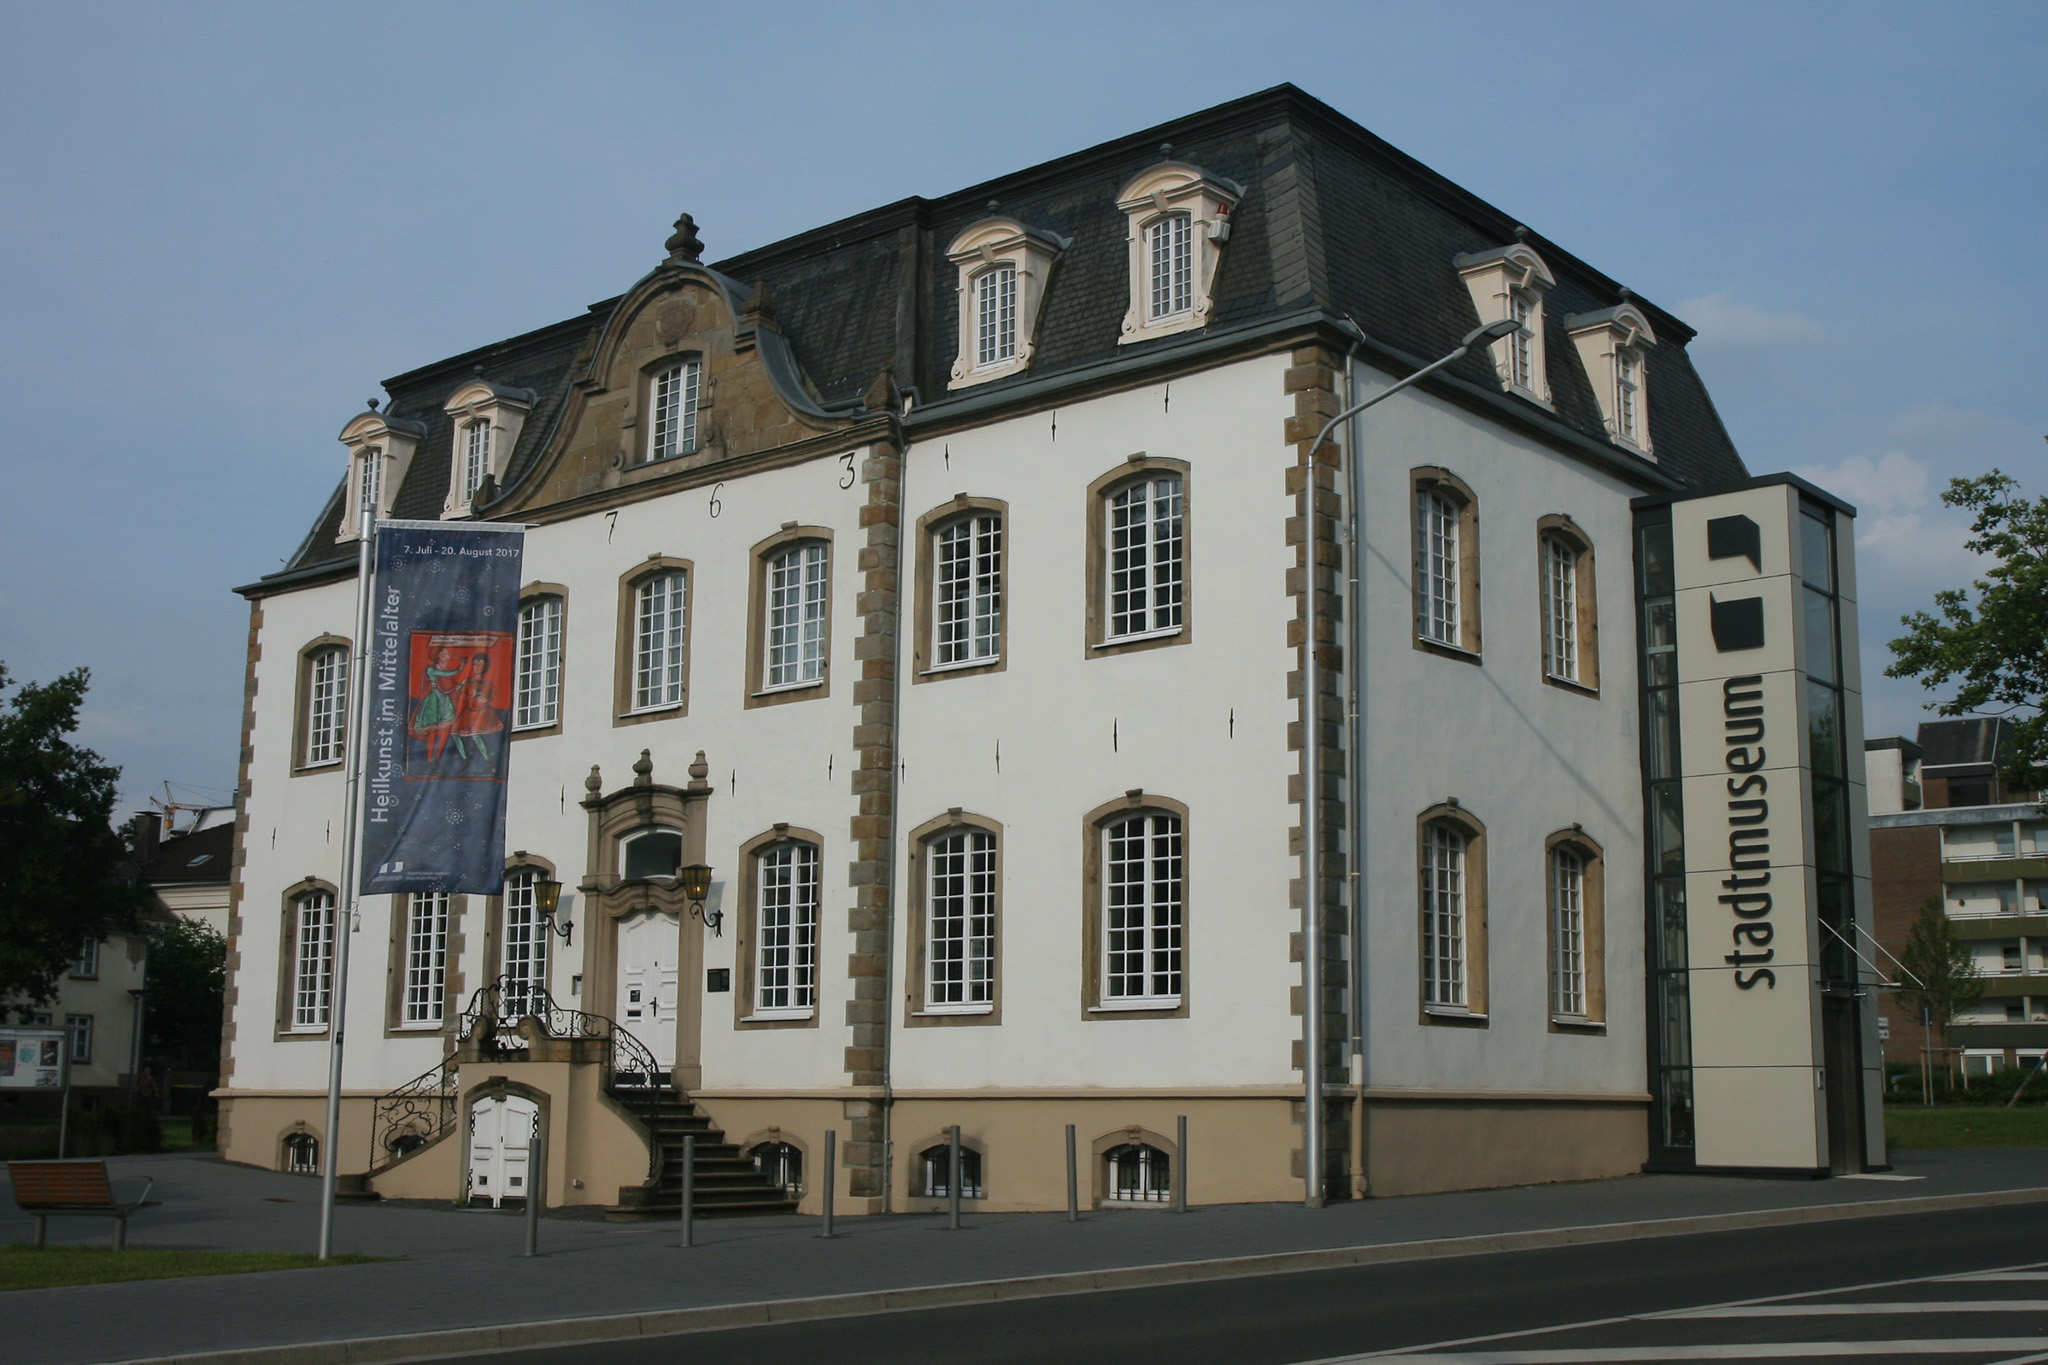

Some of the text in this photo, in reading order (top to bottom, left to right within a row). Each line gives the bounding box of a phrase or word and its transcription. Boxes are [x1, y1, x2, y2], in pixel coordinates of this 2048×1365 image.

[404, 545, 414, 555] 7.
[415, 545, 433, 555] Juli
[441, 546, 457, 556] 20.
[459, 547, 493, 559] August
[495, 548, 520, 558] 2017
[605, 452, 856, 545] 7 6 3
[370, 585, 401, 823] Heilkunst im Mittelalter
[1718, 674, 1776, 991] stadtmuseum
